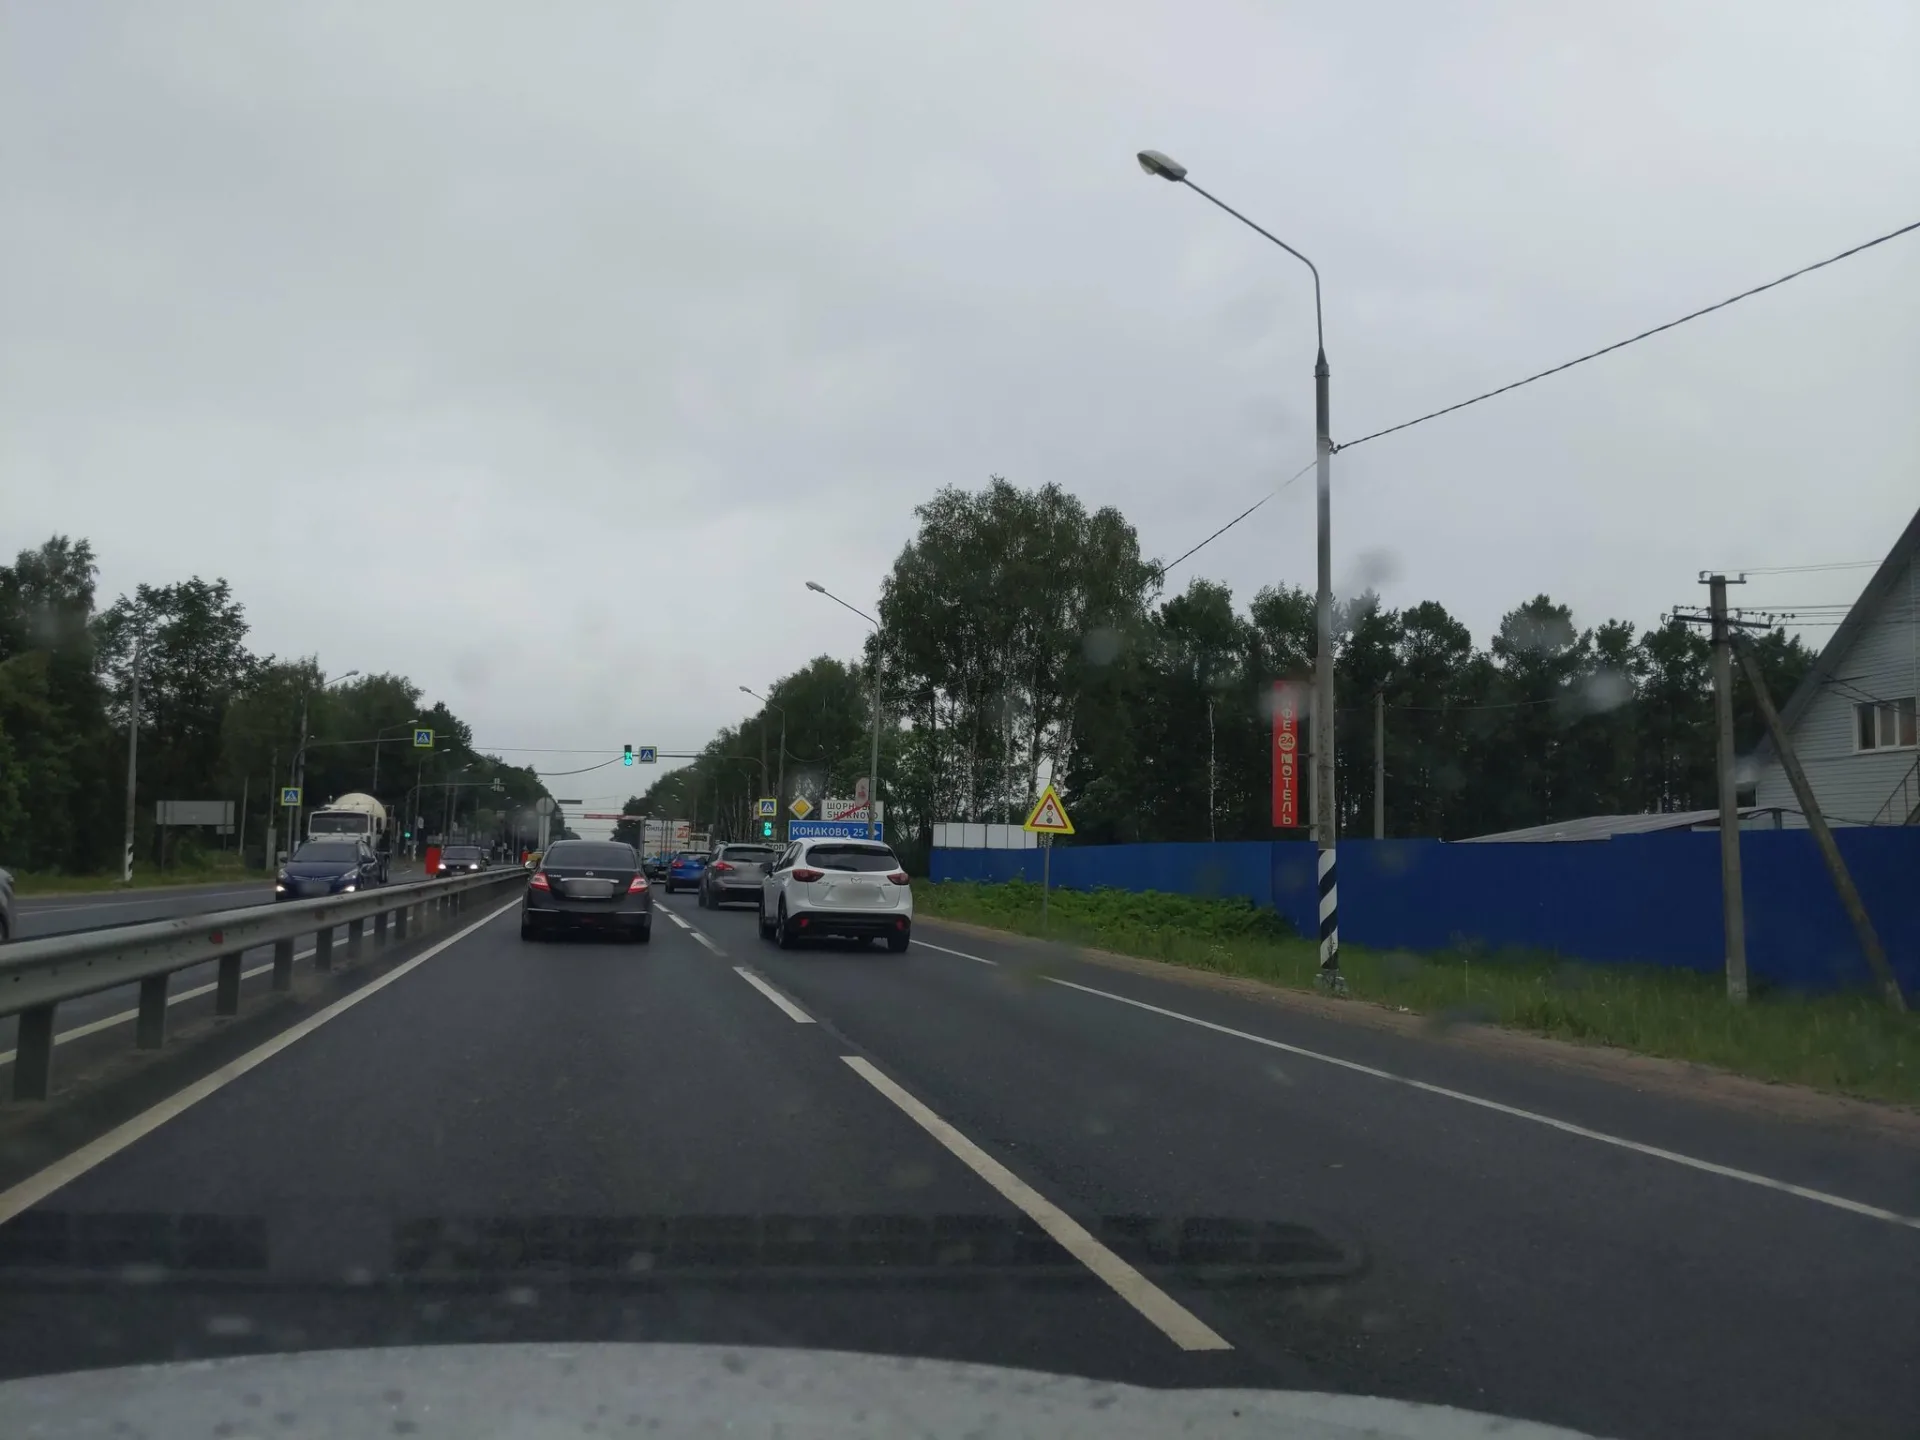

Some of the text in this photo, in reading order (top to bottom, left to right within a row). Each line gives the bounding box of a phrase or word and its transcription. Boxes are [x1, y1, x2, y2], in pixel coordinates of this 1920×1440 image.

[1281, 753, 1293, 824] МОТЕЛЬ
[827, 802, 871, 811] ШОРНВ
[792, 827, 864, 837] КОНАКОВО 25
